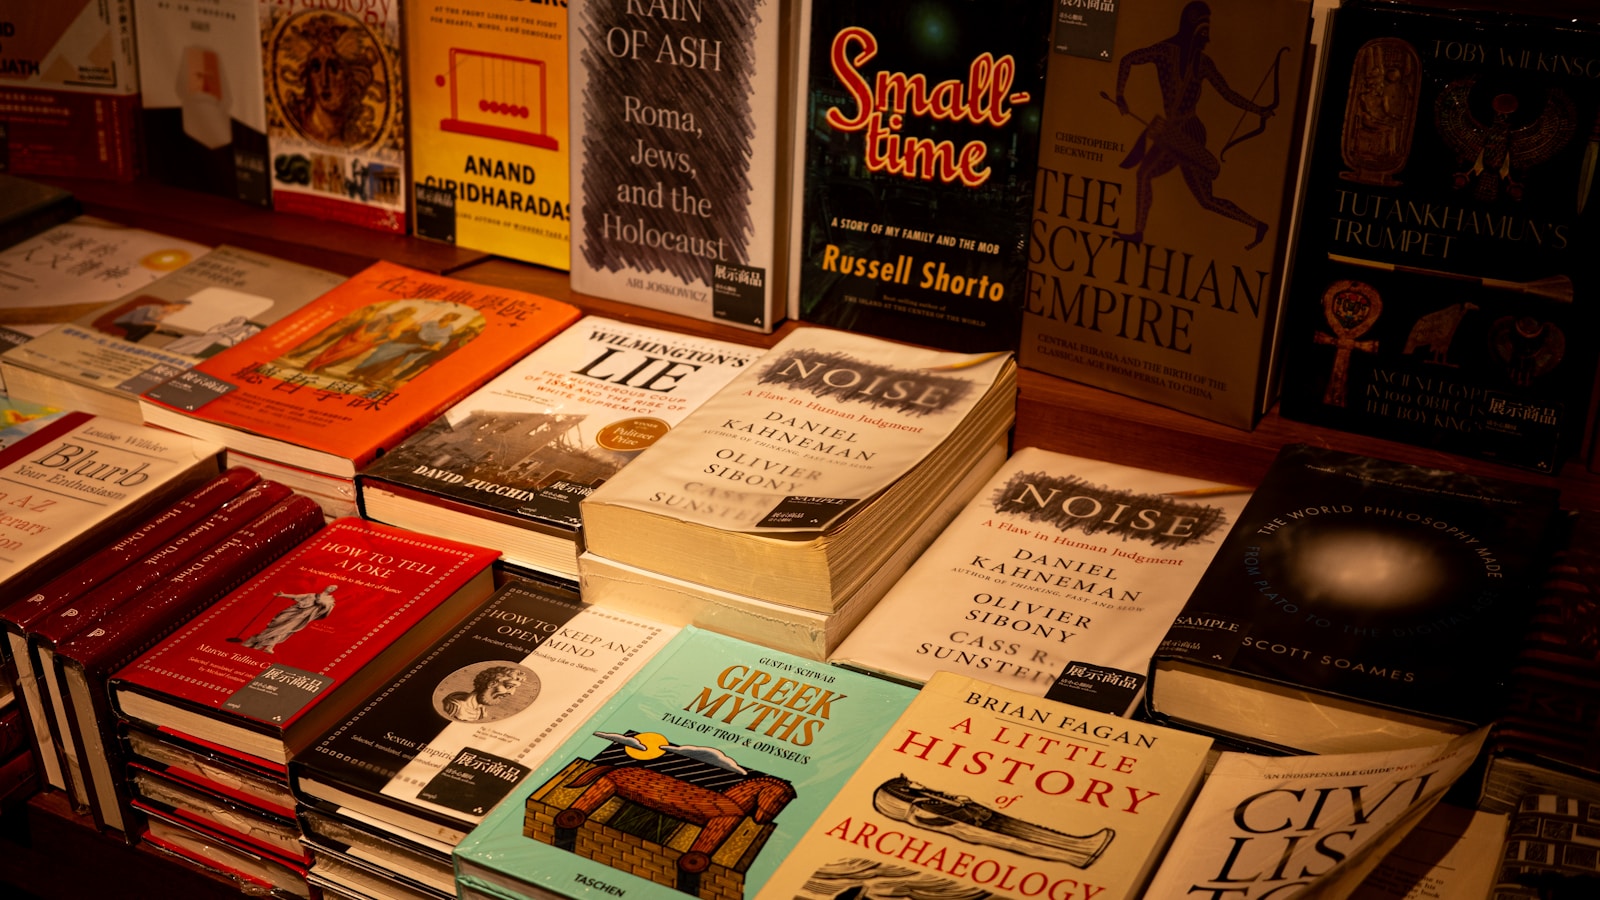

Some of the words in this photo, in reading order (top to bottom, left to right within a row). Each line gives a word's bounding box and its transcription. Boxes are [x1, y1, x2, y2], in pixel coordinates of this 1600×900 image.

[626, 0, 702, 23] RAIN
[606, 26, 649, 60] OF
[655, 33, 722, 72] ASH
[1431, 38, 1490, 64] TOBY
[826, 26, 1031, 131] Small-
[624, 95, 703, 139] Roma,
[630, 138, 697, 180] Jews,
[865, 111, 992, 187] time
[1054, 144, 1104, 163] BECKWITH
[1055, 131, 1120, 152] CHRISTOPHER
[464, 155, 536, 185] ANAND
[616, 182, 664, 209] and
[670, 186, 712, 218] the
[1036, 166, 1122, 229] THE
[831, 217, 838, 227] A
[840, 218, 868, 233] STORY
[871, 222, 883, 235] OF
[885, 225, 901, 237] MY
[902, 228, 935, 244] FAMILY
[936, 233, 957, 247] AND
[959, 237, 976, 250] THE
[977, 241, 1000, 255] MOB
[1335, 188, 1569, 250] TUTANKHAMUN'S
[602, 213, 729, 262] Holocaust
[1329, 216, 1457, 260] TRUMPET
[714, 264, 763, 288] 展示商品
[821, 243, 914, 285] Russell
[920, 260, 1005, 302] Shorto
[1027, 218, 1270, 319] SCYTHIAN
[625, 276, 644, 290] ARI
[645, 281, 708, 303] JOSKOWICZ
[1022, 269, 1194, 355] EMPIRE
[588, 330, 750, 368] WILMINGTON'S
[571, 347, 702, 394] LIE
[778, 358, 950, 410] NOISE
[1087, 356, 1105, 370] AGE
[1106, 364, 1133, 379] FROM
[1133, 370, 1166, 388] PERSIA
[1166, 379, 1181, 392] TO
[1181, 383, 1213, 400] CHINA
[1120, 351, 1142, 367] AND
[1142, 356, 1162, 371] THE
[1163, 365, 1192, 384] BIRTH
[524, 375, 543, 383] OF
[575, 387, 603, 397] AND
[606, 394, 632, 404] THE
[633, 399, 661, 409] RISE
[667, 404, 686, 413] OF
[536, 385, 573, 399] WHITE
[577, 396, 657, 415] SUPREMACY
[542, 370, 566, 380] THE
[650, 393, 687, 404] COUP
[763, 410, 859, 443] DANIEL
[1487, 397, 1558, 426] 展示商品
[82, 426, 121, 442] Louise
[611, 435, 639, 446] Prize
[613, 426, 654, 440] Pulitzer
[721, 418, 879, 463] KAHNEMAN
[14, 464, 47, 482] Your
[48, 474, 128, 501] Enthusiasm
[31, 442, 151, 488] Blurb
[703, 462, 803, 493] SIBONY
[715, 448, 824, 481] OLIVIER
[412, 465, 463, 485] DAVID
[463, 478, 536, 502] ZUCCHIN
[143, 523, 156, 533] to
[155, 508, 182, 525] How
[188, 520, 215, 538] How
[1012, 483, 1200, 539] NOISE
[112, 531, 145, 551] Drink
[144, 545, 179, 565] Drink
[175, 536, 189, 546] to
[321, 542, 368, 558] HOW
[369, 551, 394, 565] TO
[397, 558, 437, 576] TELL
[981, 519, 993, 527] A
[996, 520, 1032, 536] Flaw
[1034, 530, 1049, 542] in
[1052, 535, 1108, 554] Human
[1110, 547, 1184, 568] Judgment
[1257, 516, 1288, 538] THE
[1287, 503, 1354, 521] WORLD
[1363, 505, 1480, 546] PHILOSOPHY
[1474, 546, 1503, 580] MADE
[335, 559, 349, 568] A
[347, 562, 395, 579] JOKE
[951, 567, 992, 582] AUTHOR
[970, 555, 1142, 602] KAHNEMAN
[1012, 548, 1118, 581] DANIEL
[973, 592, 1094, 630] OLIVIER
[1254, 578, 1299, 616] PLATO
[489, 609, 533, 625] HOW
[534, 620, 558, 633] TO
[559, 628, 602, 645] KEEP
[602, 641, 631, 654] AN
[497, 625, 545, 644] OPEN
[544, 639, 595, 658] MIND
[965, 609, 1078, 644] SIBONY
[1175, 616, 1240, 633] SAMPLE
[197, 643, 229, 658] Marcus
[230, 652, 259, 666] Tullius
[949, 630, 1020, 656] CASS
[1029, 649, 1055, 666] R.
[1241, 636, 1312, 662] SCOTT
[1320, 654, 1417, 684] SOAMES
[262, 668, 323, 693] 展示商品
[759, 657, 793, 674] GUSTAV
[793, 667, 836, 684] SCHWAB
[1066, 664, 1138, 691] 展示商品
[717, 664, 848, 720] GREEK
[683, 687, 825, 747] MYTHS
[964, 692, 1052, 724] BRIAN
[1058, 716, 1158, 749] FAGAN
[383, 731, 416, 748] Sextus
[416, 742, 455, 761] Empiric
[661, 712, 697, 730] TALES
[696, 722, 712, 734] OF
[712, 727, 742, 744] TROY
[741, 737, 752, 748] &
[753, 740, 811, 765] ODYSSEUS
[950, 717, 973, 735] A
[991, 727, 1138, 774] LITTLE
[454, 752, 521, 783] 展示商品
[893, 729, 1160, 815] HISTORY
[994, 792, 1024, 810] of
[825, 816, 1107, 900] ARCHAEOLOGY
[573, 873, 625, 898] TASCHEN
